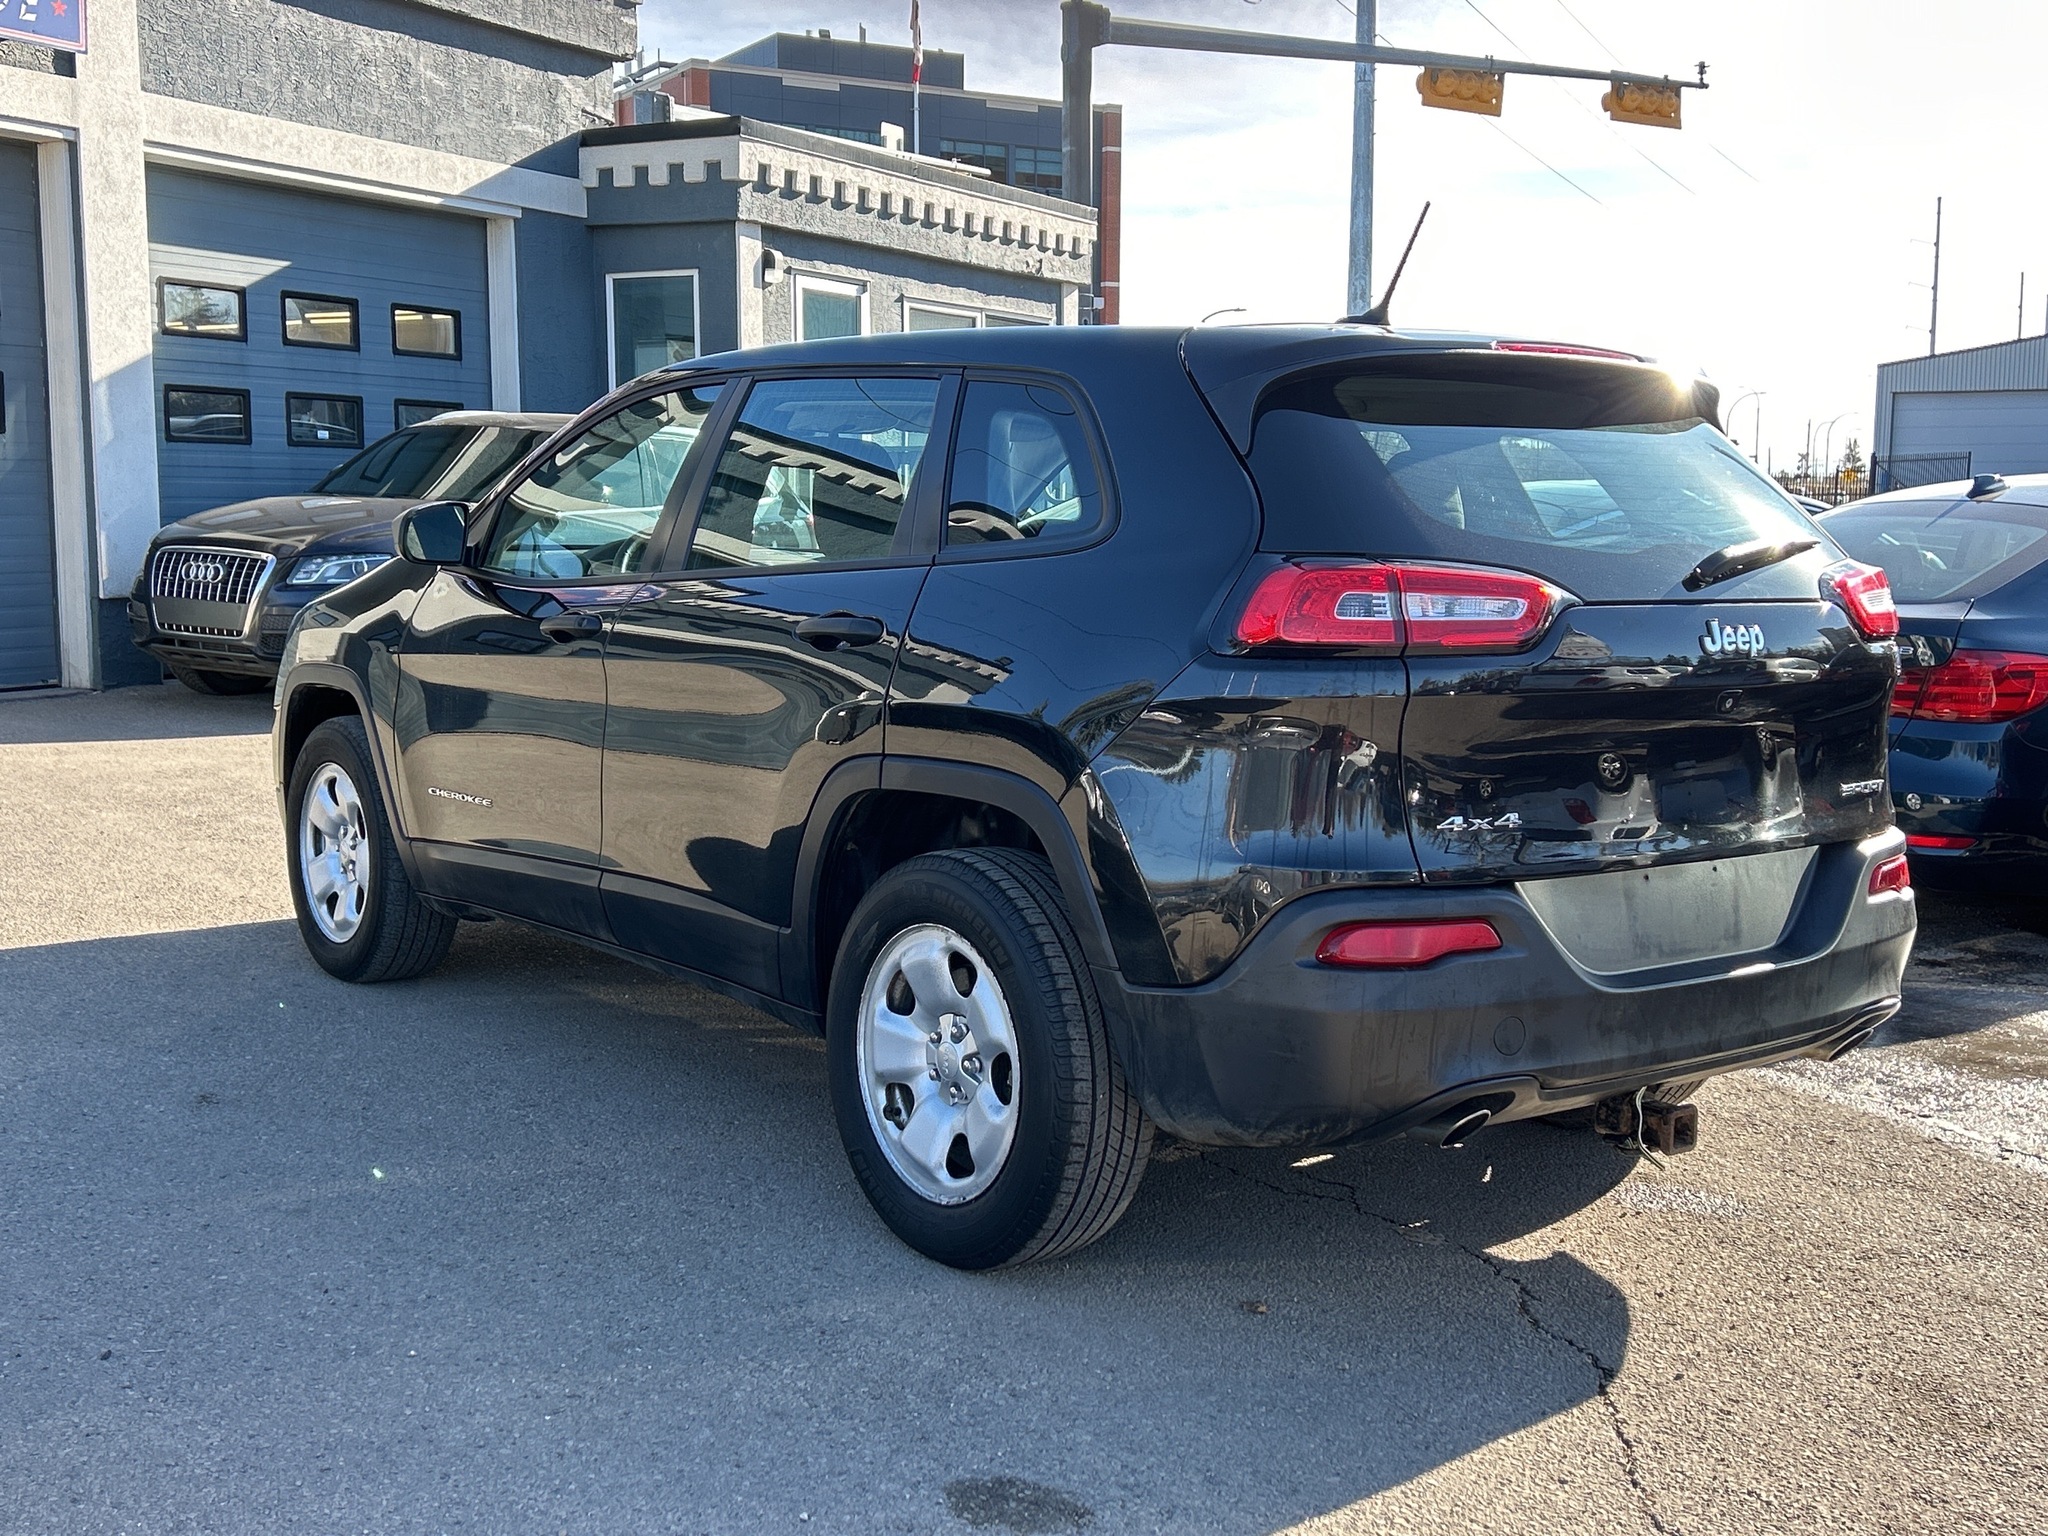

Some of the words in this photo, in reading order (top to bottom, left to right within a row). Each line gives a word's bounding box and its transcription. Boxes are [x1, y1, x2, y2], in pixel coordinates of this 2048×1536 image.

[1700, 617, 1765, 657] Jeep
[428, 786, 494, 808] CHEROKEE
[1437, 812, 1522, 831] 4x4
[933, 888, 1009, 966] MICHELIN
